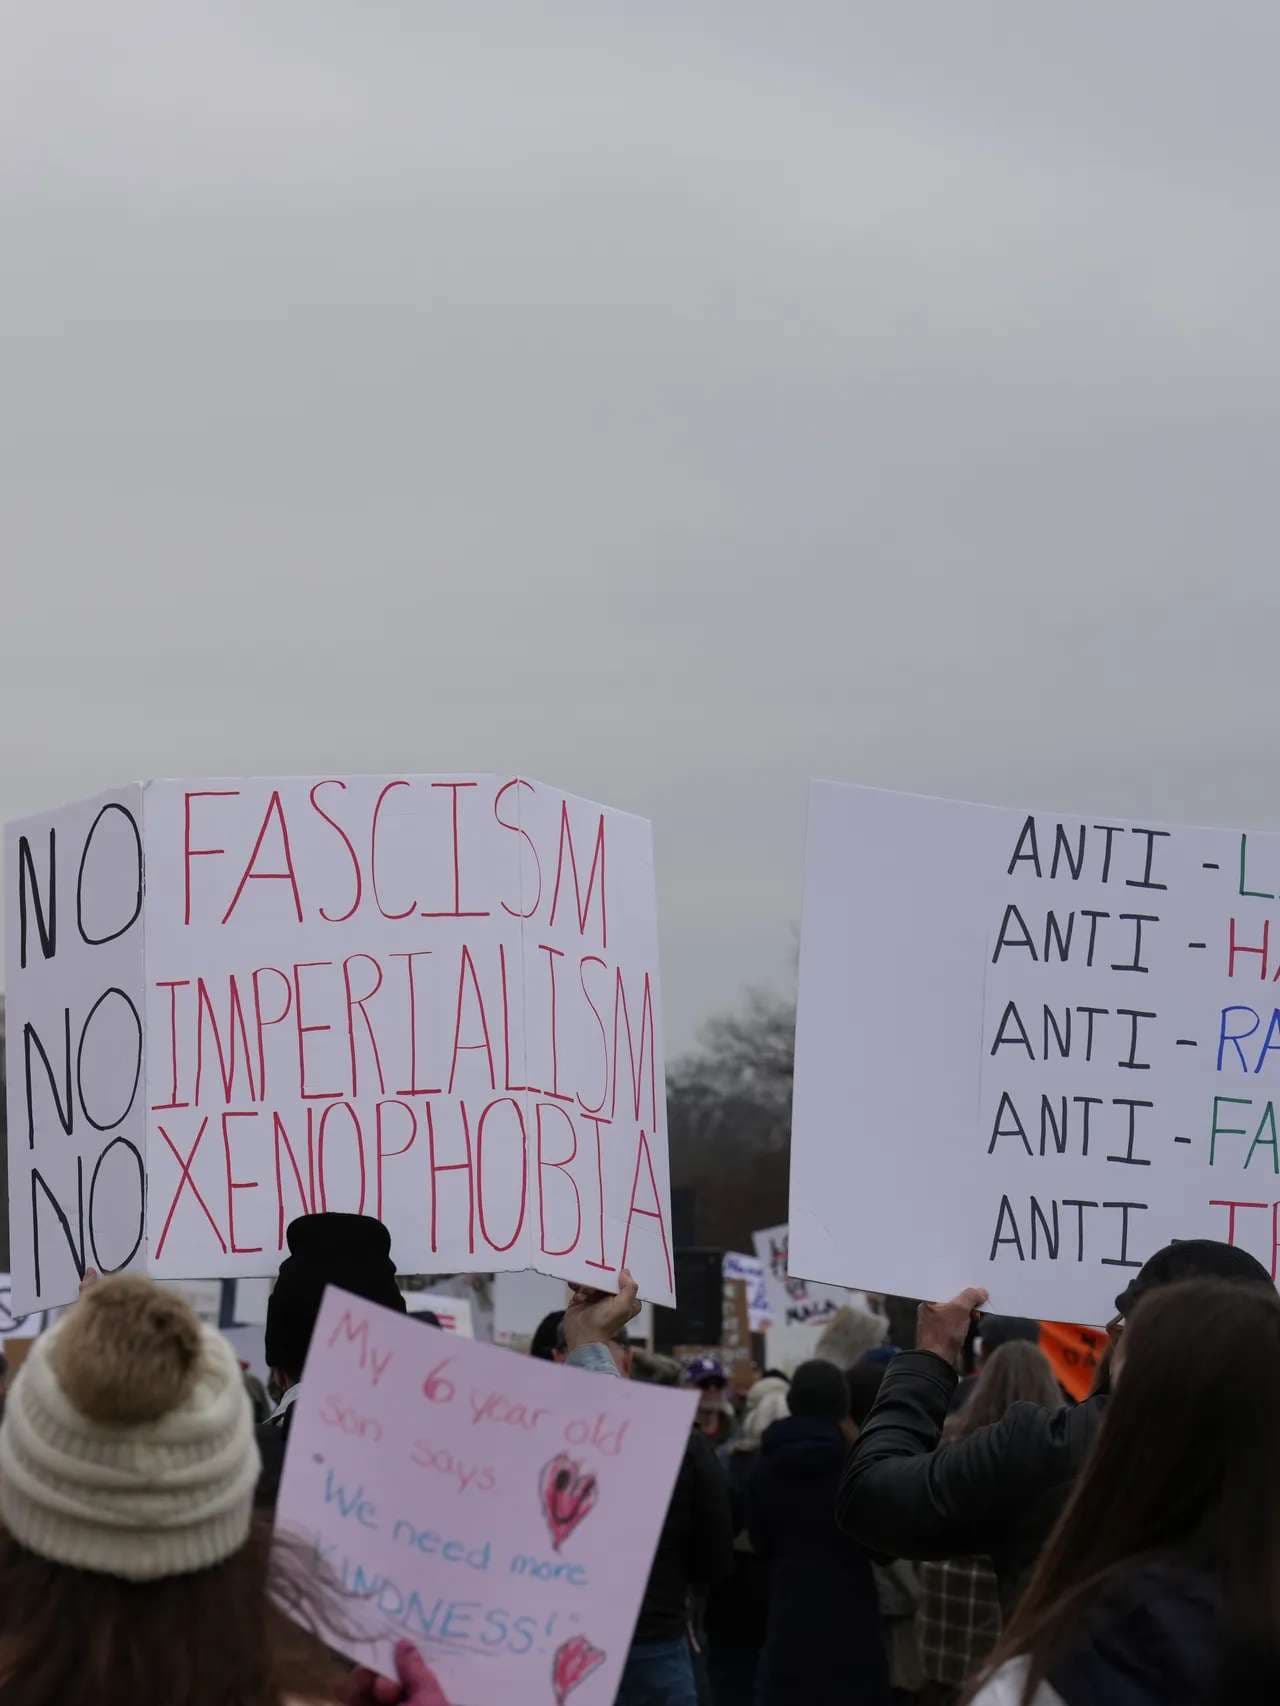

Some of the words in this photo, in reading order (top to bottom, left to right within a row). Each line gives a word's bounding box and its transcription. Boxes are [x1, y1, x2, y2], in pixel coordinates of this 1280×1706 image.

[18, 802, 143, 969] NO
[182, 778, 608, 949] FASCISM
[23, 986, 143, 1150] NO
[151, 943, 657, 1134] IMPERIALISM
[30, 1135, 146, 1298] NO
[154, 1097, 675, 1294] XENOPHOBIA
[328, 1309, 393, 1387] My
[422, 1354, 457, 1404] 6
[468, 1386, 546, 1431] year
[563, 1408, 631, 1456] old
[409, 1436, 498, 1493] says
[392, 1516, 492, 1570] need
[510, 1550, 590, 1587] more
